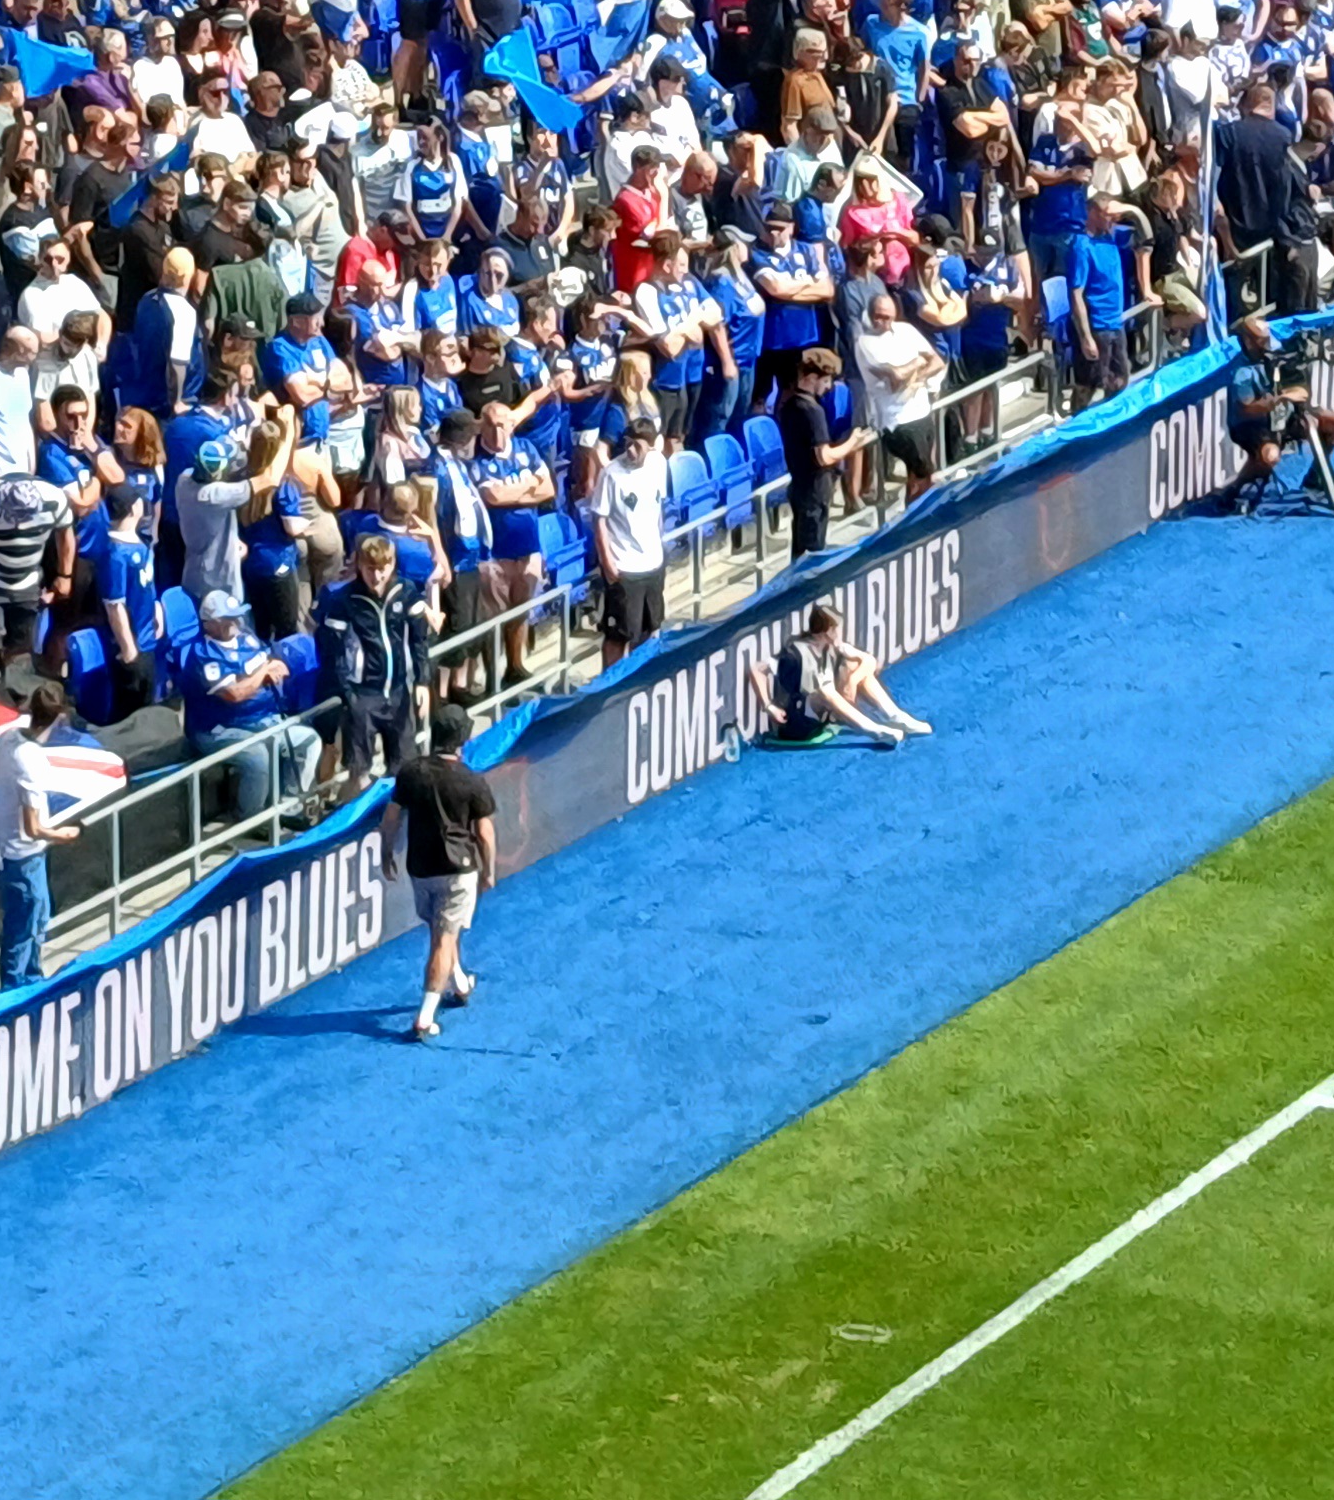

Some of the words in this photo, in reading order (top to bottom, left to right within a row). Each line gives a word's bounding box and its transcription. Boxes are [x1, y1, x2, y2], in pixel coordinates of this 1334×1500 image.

[627, 649, 726, 804] COME
[868, 529, 960, 671] BLUES
[93, 947, 152, 1100] ON
[165, 898, 248, 1055] YOU
[259, 831, 383, 1008] BLUES
